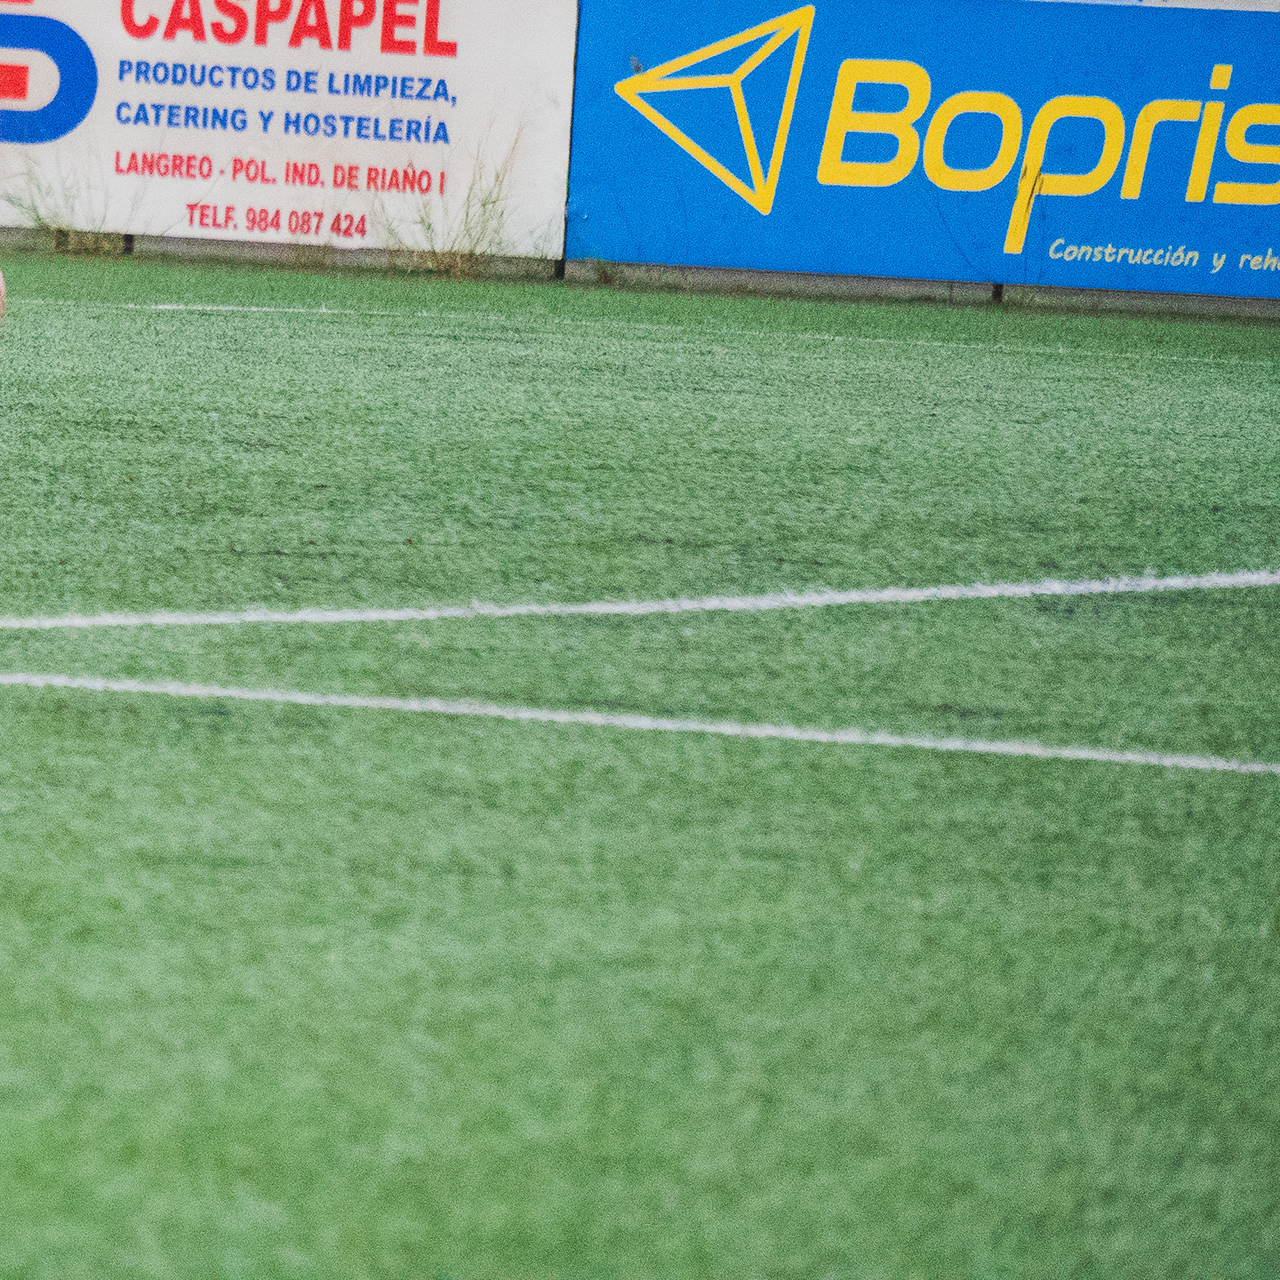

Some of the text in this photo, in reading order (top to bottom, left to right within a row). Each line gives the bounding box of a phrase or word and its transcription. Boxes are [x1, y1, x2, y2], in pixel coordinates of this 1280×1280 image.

[118, 59, 457, 107] PRODUCTOS DE LIMPIEZA,
[115, 102, 451, 145] CATERING Y HOSTELERÍA
[114, 151, 213, 180] LANGREO
[231, 157, 277, 185] POL.
[285, 161, 325, 188] IND.
[332, 164, 360, 191] DE
[366, 161, 432, 195] RIAÑO
[186, 203, 367, 239] TELF. 984 087 424
[1048, 238, 1280, 273] Construcción y reh
